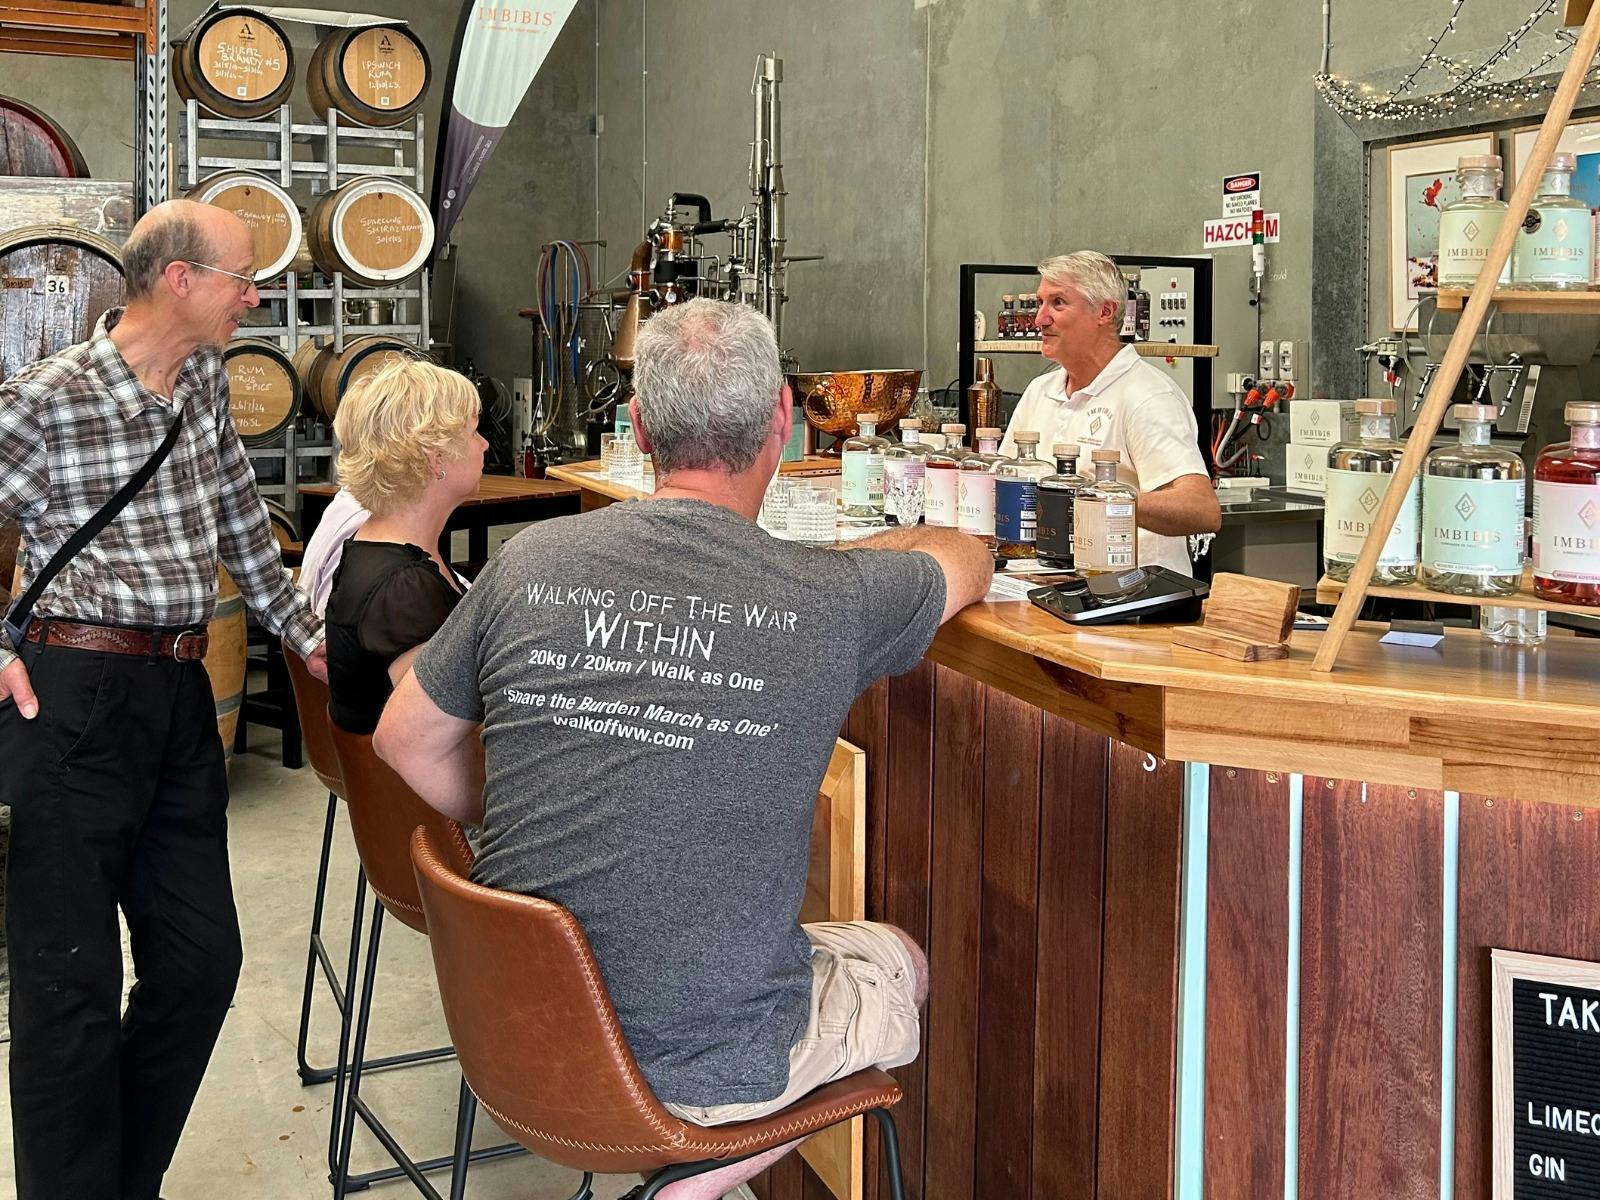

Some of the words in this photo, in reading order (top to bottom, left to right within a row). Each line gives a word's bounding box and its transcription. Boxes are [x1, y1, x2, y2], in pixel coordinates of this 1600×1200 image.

[479, 7, 553, 26] IMBIBIS
[217, 42, 261, 57] SHIRAZ
[221, 52, 263, 71] BRANDY
[265, 57, 280, 71] #5
[362, 60, 400, 70] IPSWICH
[369, 70, 392, 79] RUM
[1230, 180, 1252, 188] DANGER
[366, 225, 399, 235] SHIRAZ
[1205, 219, 1278, 243] HAZCHM
[1447, 248, 1488, 257] IMBIBI
[48, 280, 65, 293] 36
[238, 364, 264, 376] RUM
[231, 375, 256, 384] ITRUS
[245, 383, 272, 391] SPICE
[1338, 520, 1402, 535] IMBIS
[584, 609, 715, 661] WITHIN
[528, 649, 567, 670] 20kg
[570, 652, 581, 668] /
[583, 654, 632, 673] 20km
[636, 660, 647, 674] /
[651, 660, 696, 681] Walk
[701, 671, 723, 685] as
[728, 672, 764, 691] One
[550, 693, 576, 710] the
[577, 696, 640, 716] Burden
[643, 703, 704, 729] March
[706, 718, 731, 732] as
[553, 715, 695, 750] walkoffww.com
[1529, 1153, 1566, 1181] GIN
